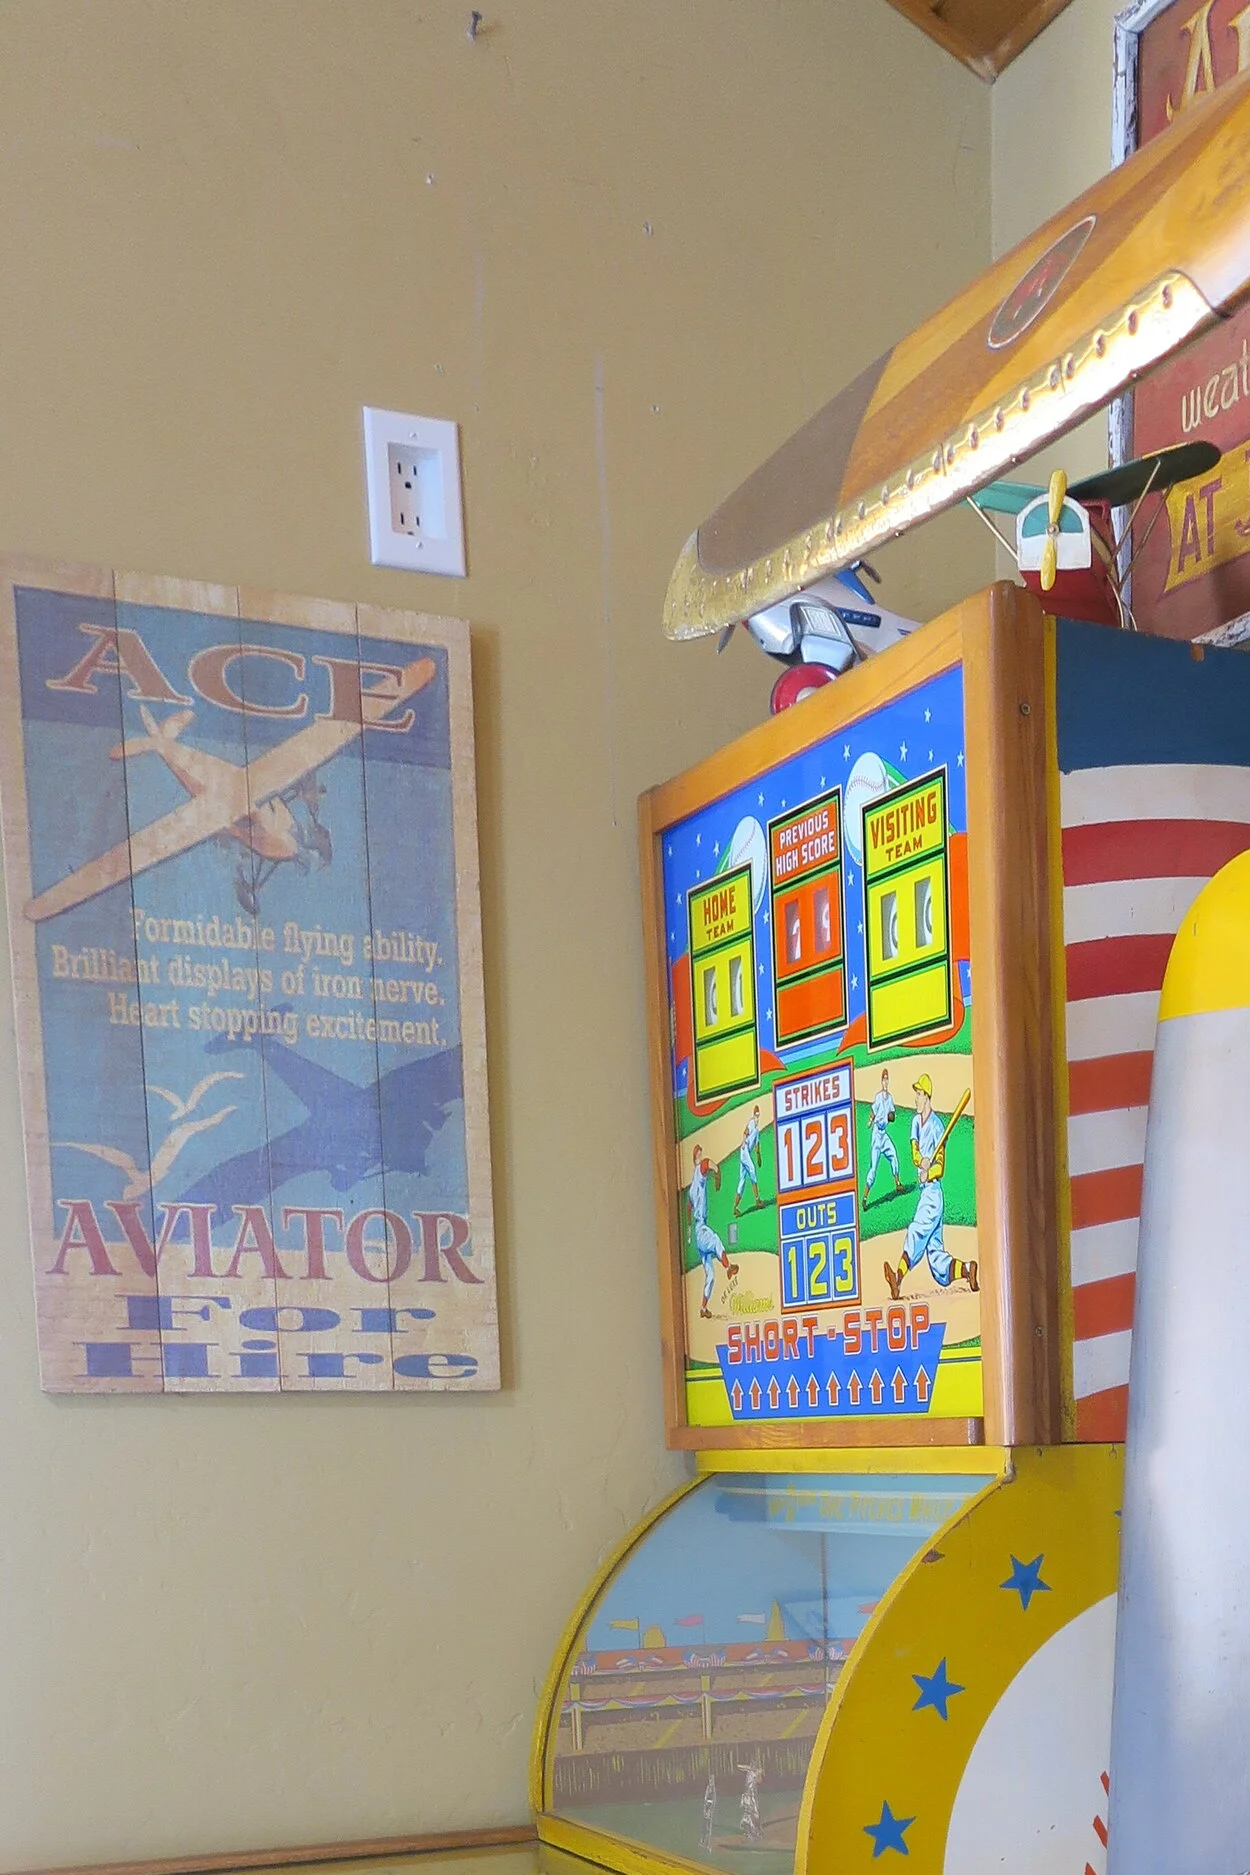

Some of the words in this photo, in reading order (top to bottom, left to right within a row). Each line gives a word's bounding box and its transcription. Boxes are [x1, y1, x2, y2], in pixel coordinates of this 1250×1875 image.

[1174, 477, 1222, 572] AT
[46, 621, 416, 732] ACE
[779, 810, 829, 849] PREVIOUS
[870, 790, 937, 849] VISITING
[775, 850, 799, 878] HIGH
[801, 830, 836, 866] SCORE
[885, 835, 923, 863] TEAM
[703, 886, 736, 927] HOME
[706, 919, 734, 942] TEAM
[130, 908, 274, 953] Formidable
[282, 920, 355, 964] flying
[362, 928, 446, 972] ability.
[51, 944, 159, 986] Brilliant
[167, 956, 274, 999] displays
[281, 963, 306, 998] of
[312, 966, 363, 1001] iron
[368, 972, 446, 1007] nerve.
[108, 990, 181, 1030] Heart
[187, 999, 298, 1044] stopping
[305, 1009, 448, 1047] excitement.
[784, 1075, 840, 1112] STRIKES
[783, 1127, 795, 1183] 1
[805, 1120, 824, 1178] 2
[830, 1115, 849, 1172] 3
[47, 1197, 486, 1285] AVIATOR
[796, 1201, 836, 1230] OUTS
[787, 1246, 799, 1300] 1
[809, 1240, 829, 1297] 2
[834, 1236, 854, 1292] 3
[115, 1292, 437, 1334] For
[727, 1314, 818, 1365] SHORT
[843, 1302, 932, 1356] STOP
[76, 1340, 482, 1381] Hire
